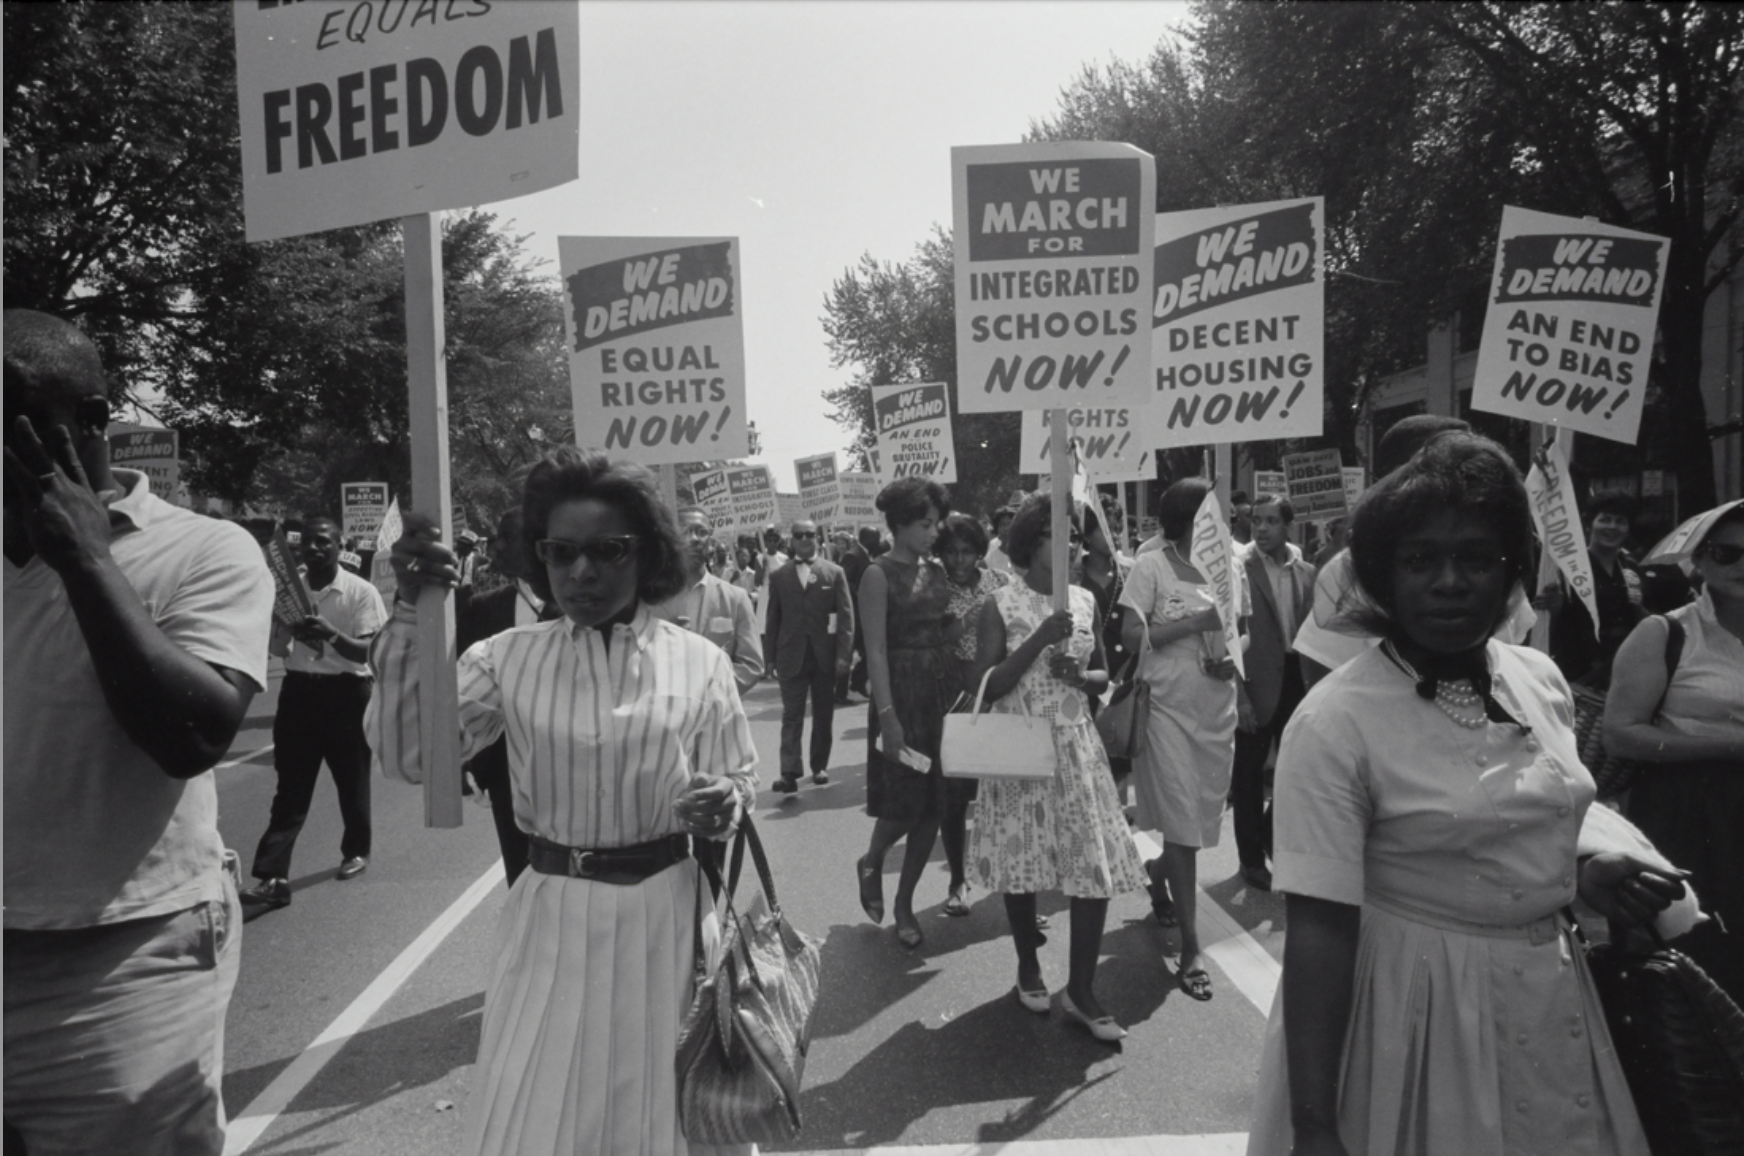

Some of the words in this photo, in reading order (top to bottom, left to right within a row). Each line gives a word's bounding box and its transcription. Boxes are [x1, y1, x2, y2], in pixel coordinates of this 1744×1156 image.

[316, 0, 492, 51] EQUALS
[263, 26, 564, 175] FREEDOM
[1029, 167, 1081, 194] WE
[981, 197, 1128, 234] MARCH
[1027, 236, 1084, 253] FOR
[1196, 220, 1260, 268] WE
[1552, 237, 1615, 265] WE
[623, 253, 681, 293] WE
[970, 266, 1140, 301] INTEGRATED
[1153, 242, 1310, 318] DEMAND
[1506, 266, 1652, 297] DEMAND
[584, 277, 728, 339] DEMAND
[971, 308, 1138, 342] SCHOOLS
[1169, 315, 1300, 352] DECENT
[1506, 309, 1559, 339] AN
[1569, 319, 1640, 356] END
[601, 345, 720, 374] EQUAL
[984, 344, 1131, 394] NOW!
[1156, 353, 1313, 391] HOUSING
[1506, 338, 1549, 367] TO
[1558, 348, 1634, 386] BIAS
[601, 377, 726, 407] RIGHTS
[898, 389, 924, 408] WE
[1167, 380, 1306, 430] NOW!
[1500, 369, 1630, 420] NOW!
[604, 405, 732, 450] NOW!
[882, 399, 943, 429] DEMAND
[1042, 409, 1130, 428] RGHTS
[130, 432, 155, 445] WE
[889, 430, 910, 440] AN
[914, 428, 941, 438] END
[901, 441, 933, 452] POLICE
[113, 443, 172, 460] DEMAND
[892, 451, 940, 463] BRUTALITY
[707, 472, 722, 486] WE
[731, 475, 766, 488] MARCH
[802, 465, 833, 481] MARCH
[893, 456, 949, 478] NOW!
[1288, 464, 1323, 480] JOBS
[348, 493, 382, 501] MARCH
[1290, 478, 1342, 496] FREEDOM
[733, 500, 774, 514] SCHOOLS
[739, 508, 775, 525] NOW!
[809, 503, 840, 520] NOW!
[1534, 460, 1577, 559] FREEDOM
[269, 540, 288, 577] MARCH
[1193, 511, 1231, 607] FREEDOM
[1567, 560, 1579, 573] IN
[1572, 571, 1593, 599] '63
